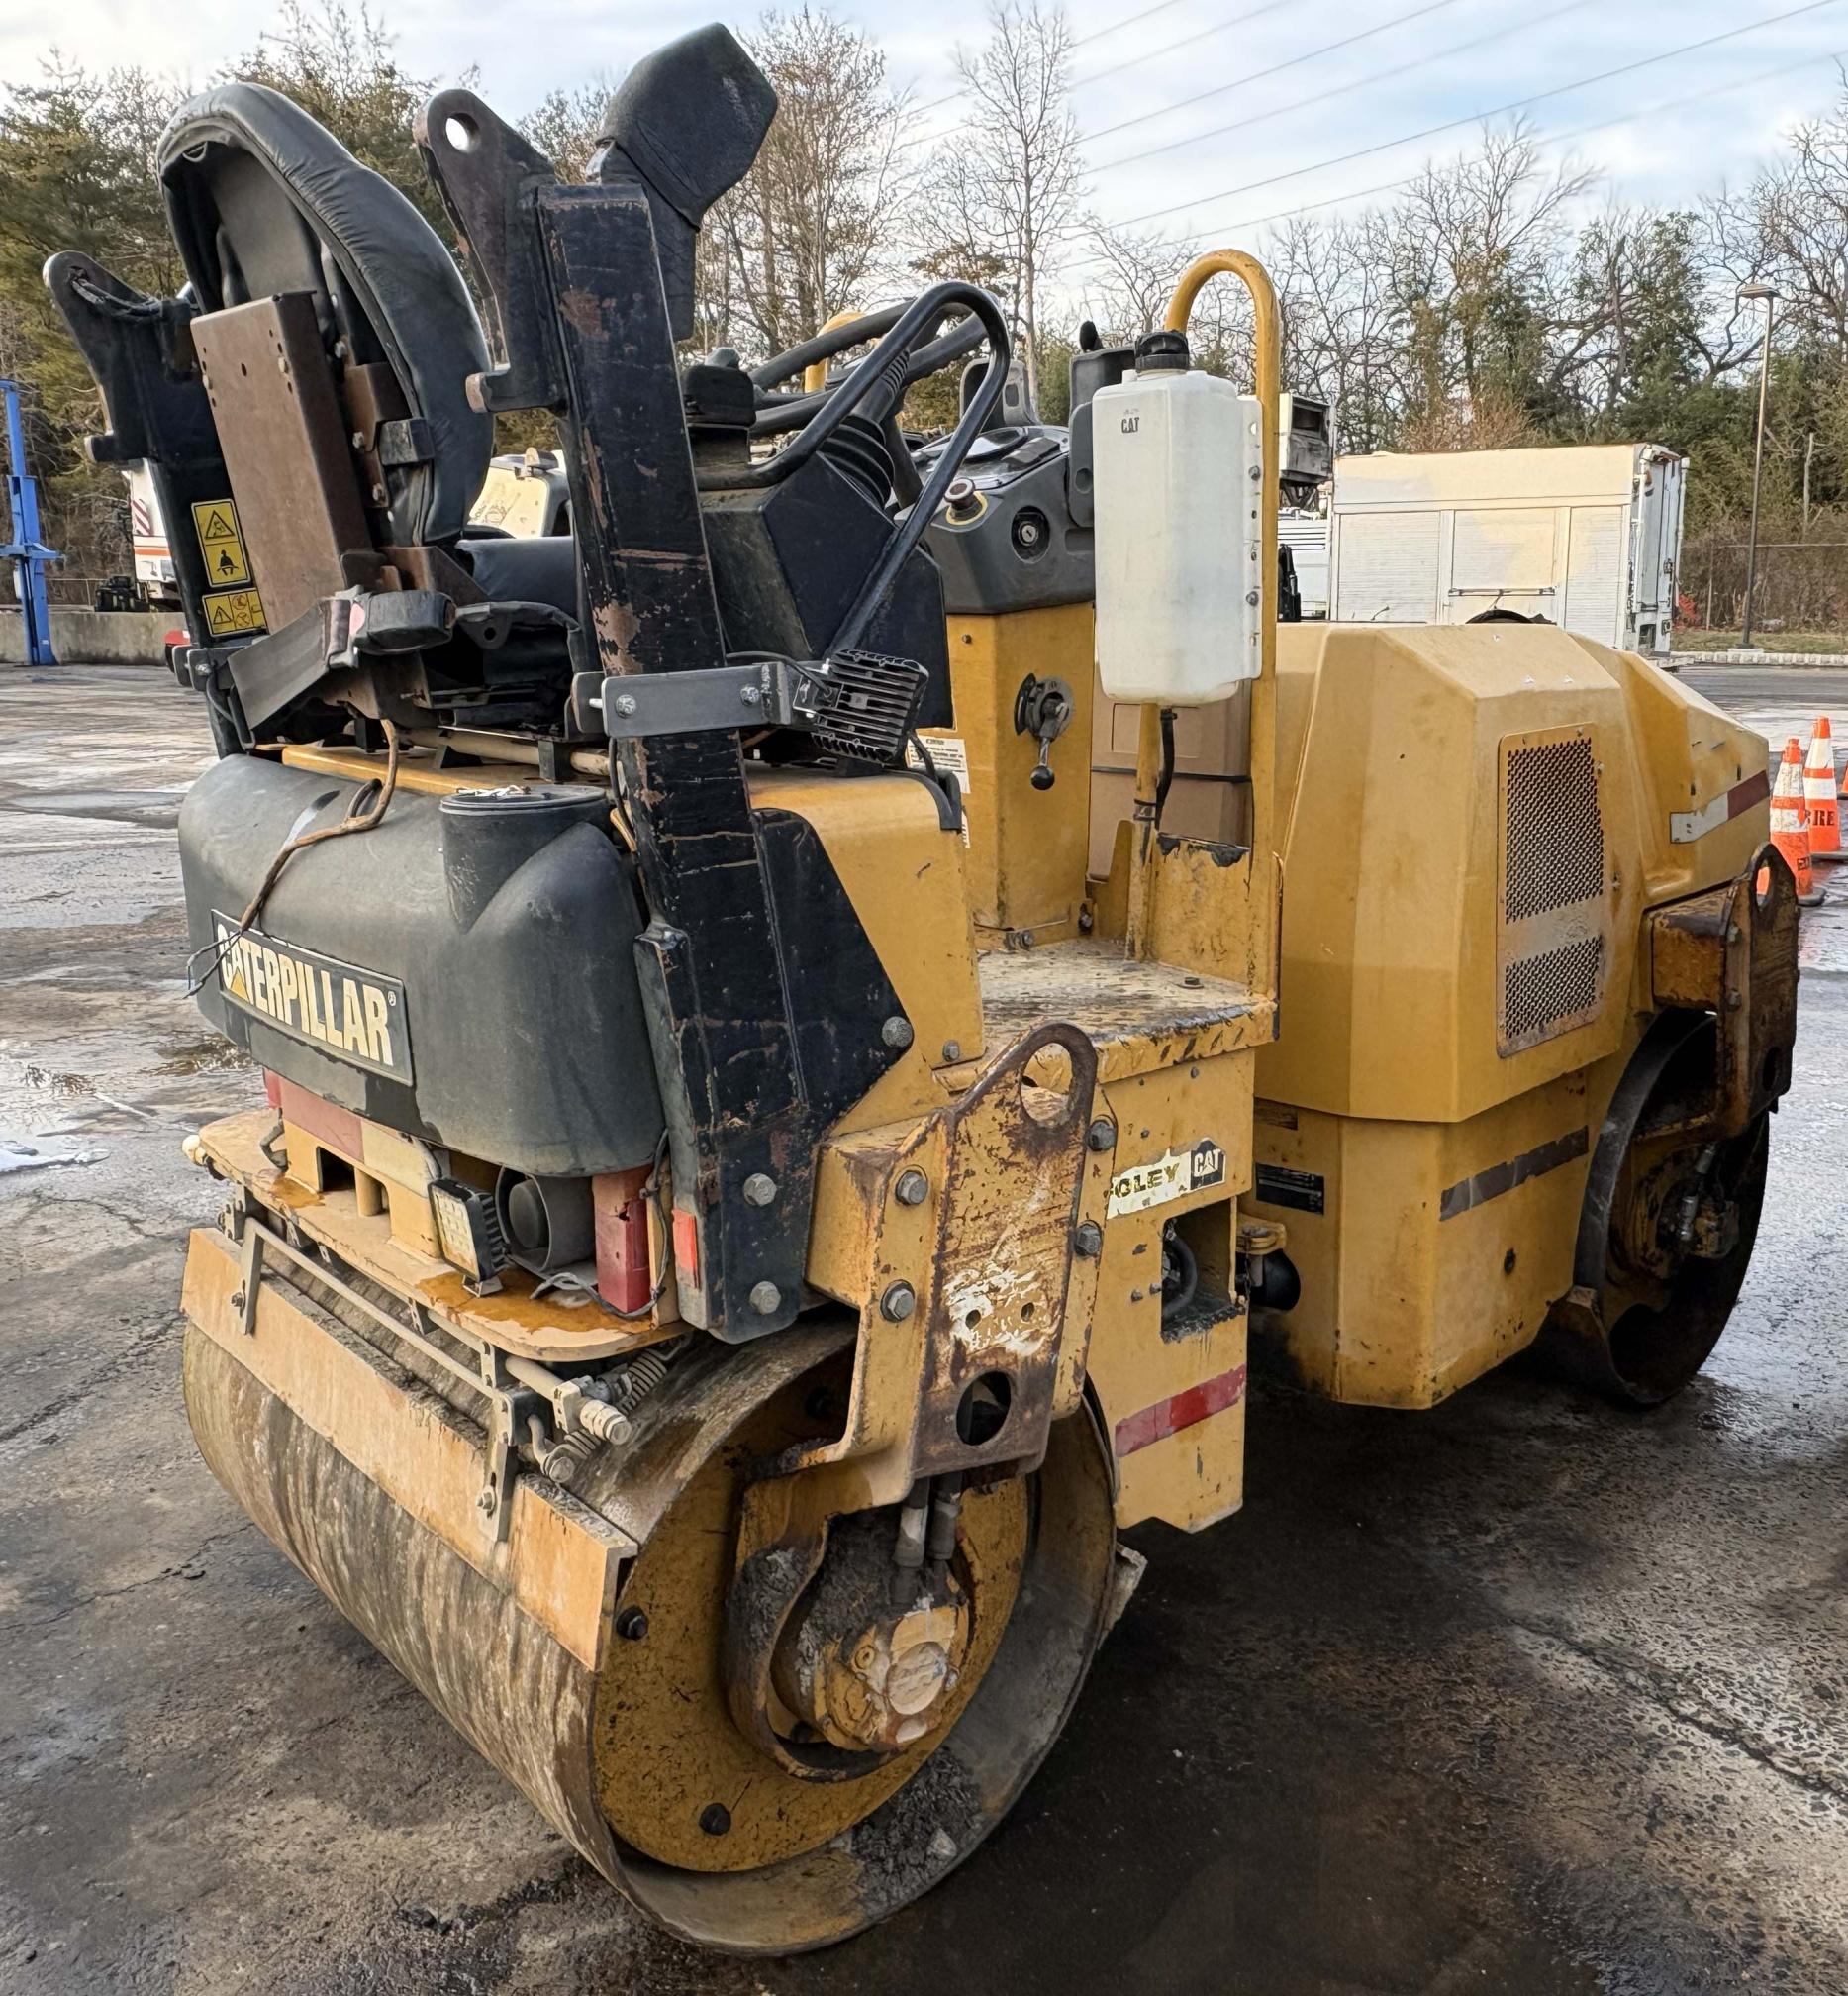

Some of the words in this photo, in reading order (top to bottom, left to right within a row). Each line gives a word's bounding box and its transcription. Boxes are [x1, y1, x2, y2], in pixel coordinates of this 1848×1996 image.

[1121, 417, 1140, 434] CAT
[217, 923, 394, 1067] CATERPILLAR
[1110, 1163, 1179, 1198] OLEY
[1194, 1148, 1221, 1177] CAT
